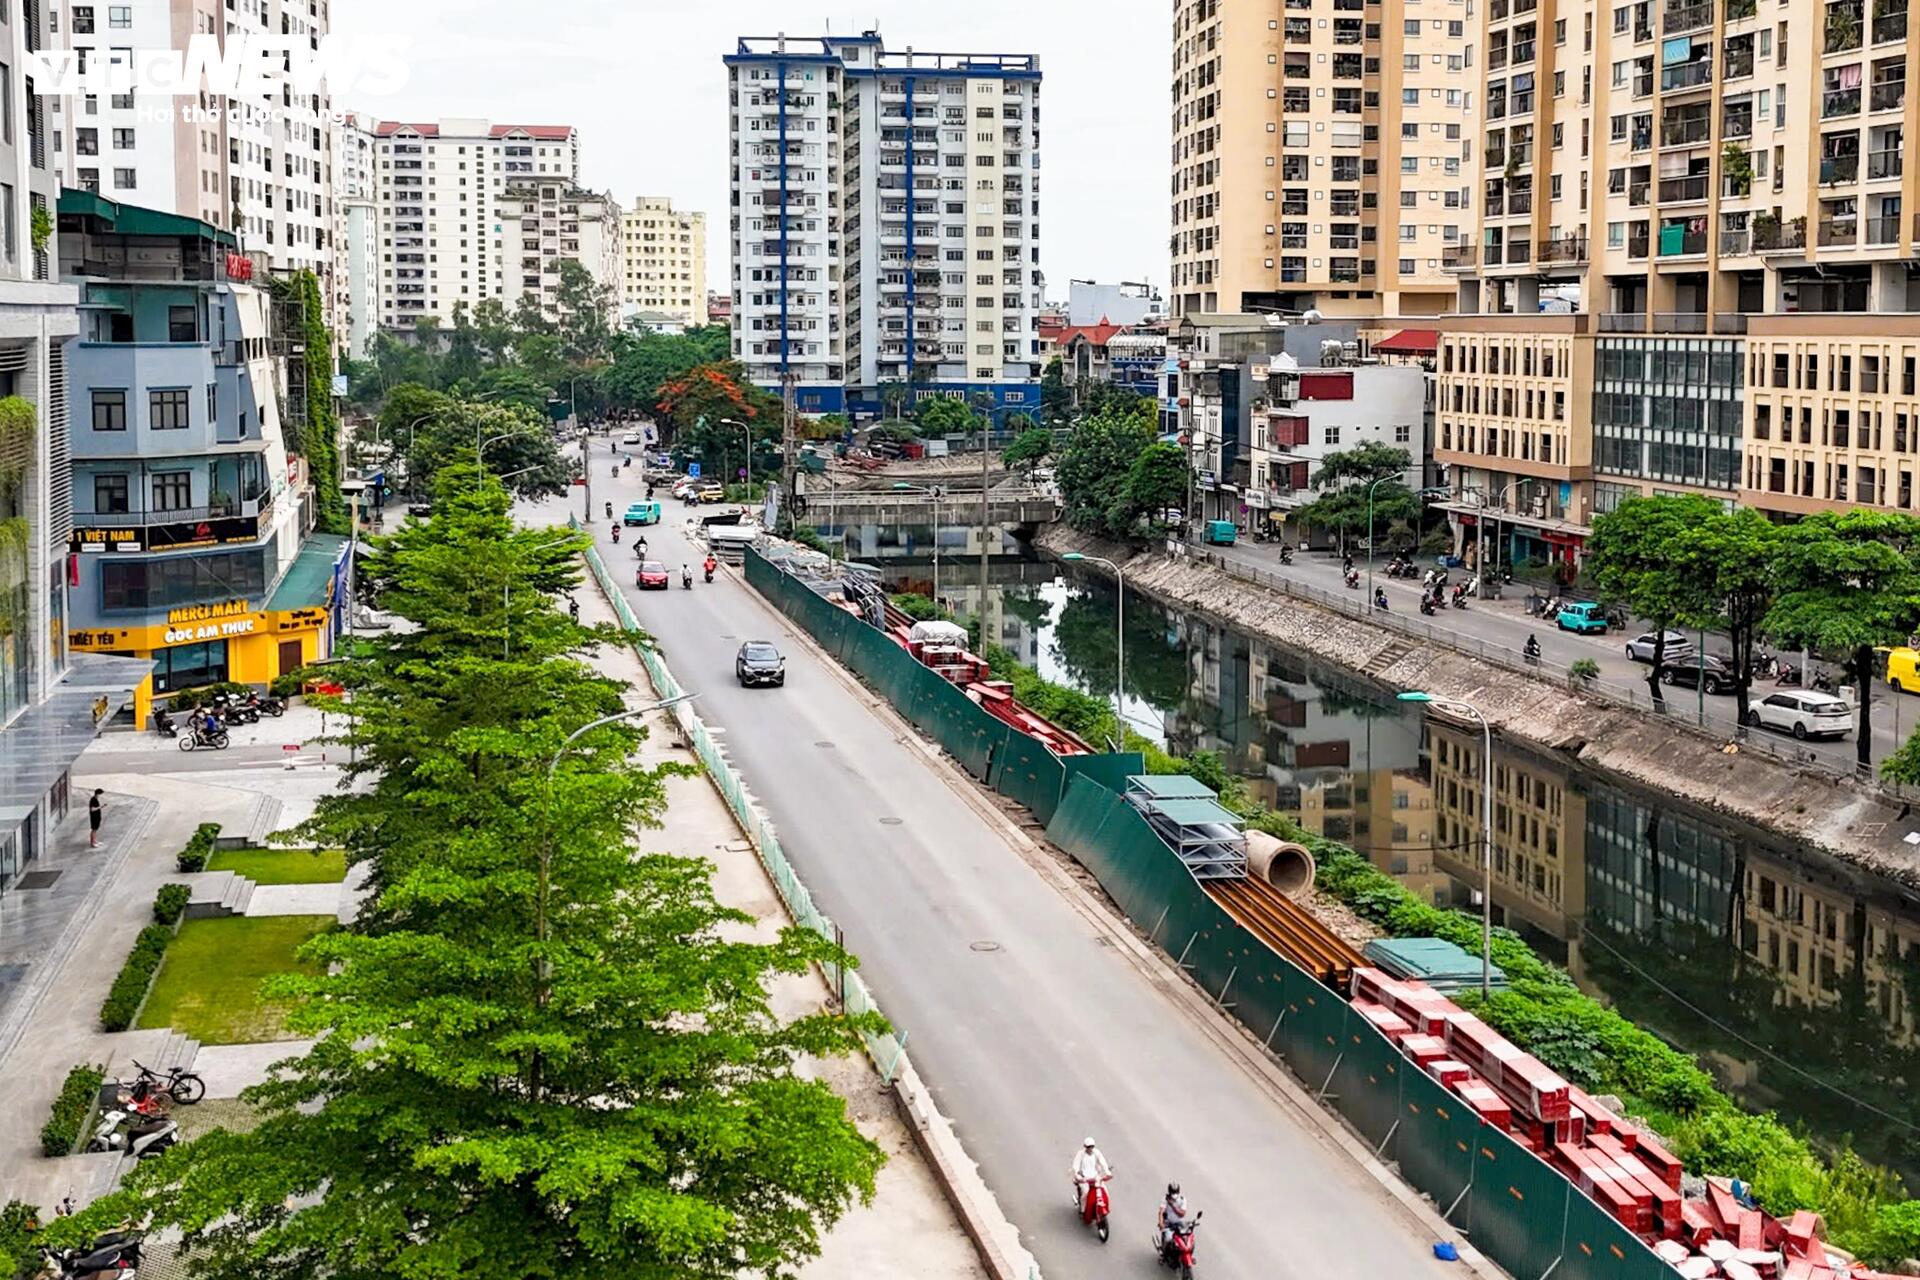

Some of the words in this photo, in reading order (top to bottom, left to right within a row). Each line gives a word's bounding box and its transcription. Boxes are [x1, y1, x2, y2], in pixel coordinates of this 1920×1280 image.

[84, 529, 108, 543] VIỆT
[110, 530, 135, 542] NAM
[169, 603, 209, 624] MERCI
[211, 599, 249, 618] MART
